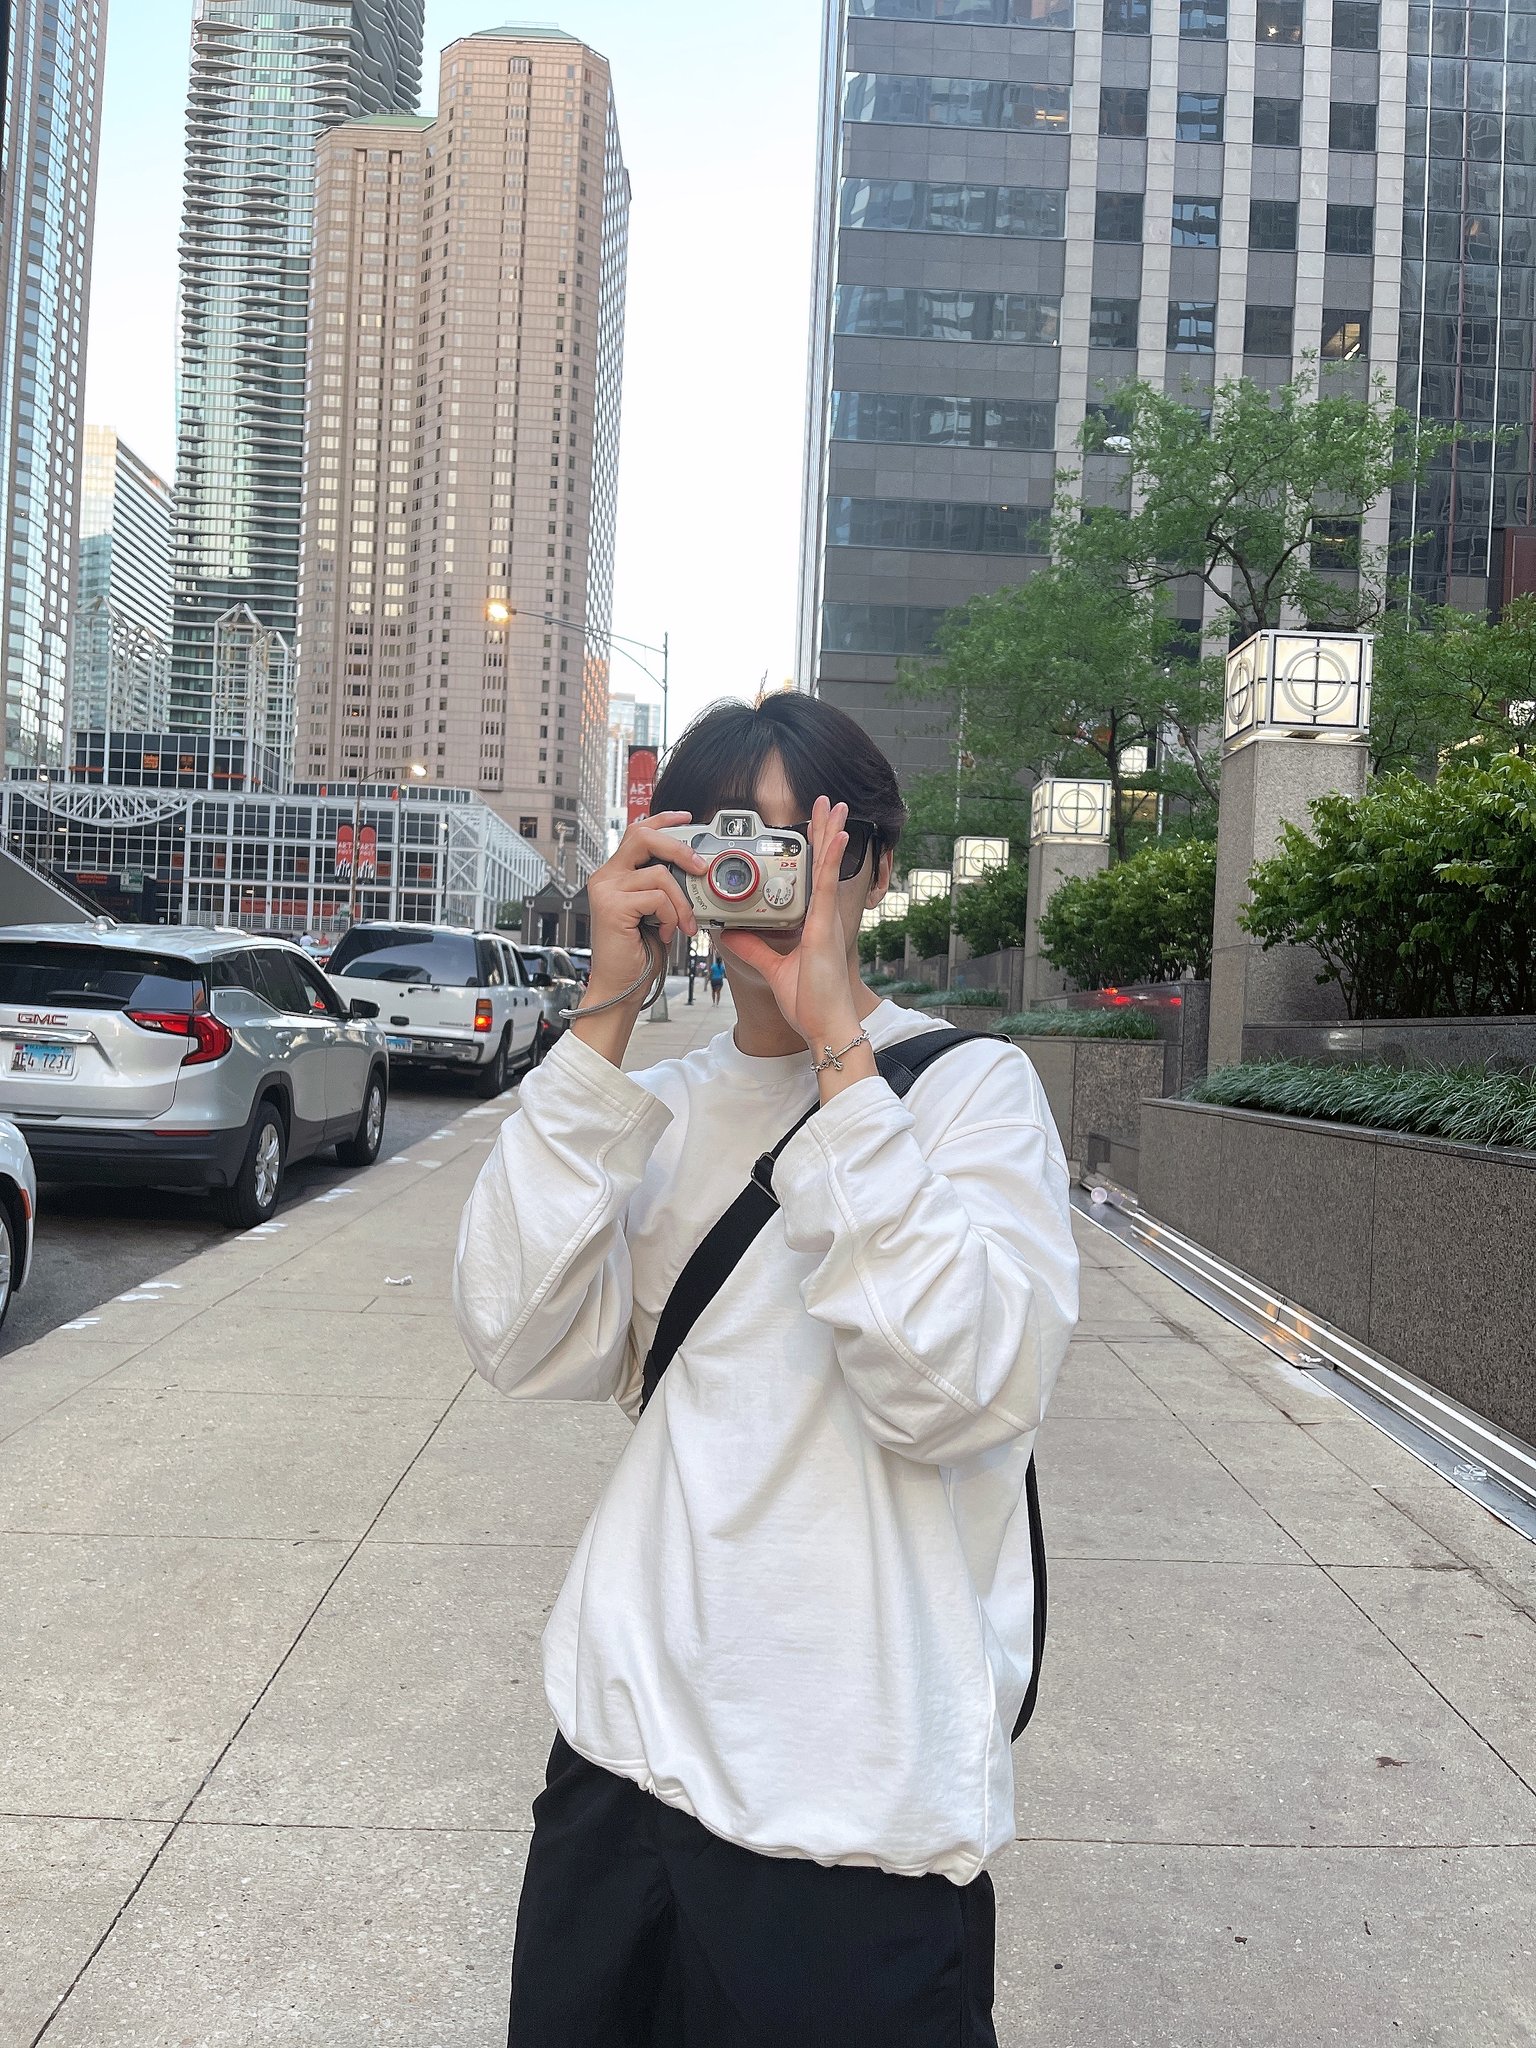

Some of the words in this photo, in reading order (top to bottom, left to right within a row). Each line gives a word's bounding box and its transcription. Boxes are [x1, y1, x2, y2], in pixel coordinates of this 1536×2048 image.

[630, 782, 654, 795] ART
[18, 1013, 68, 1026] GMC
[43, 1053, 71, 1070] 7237
